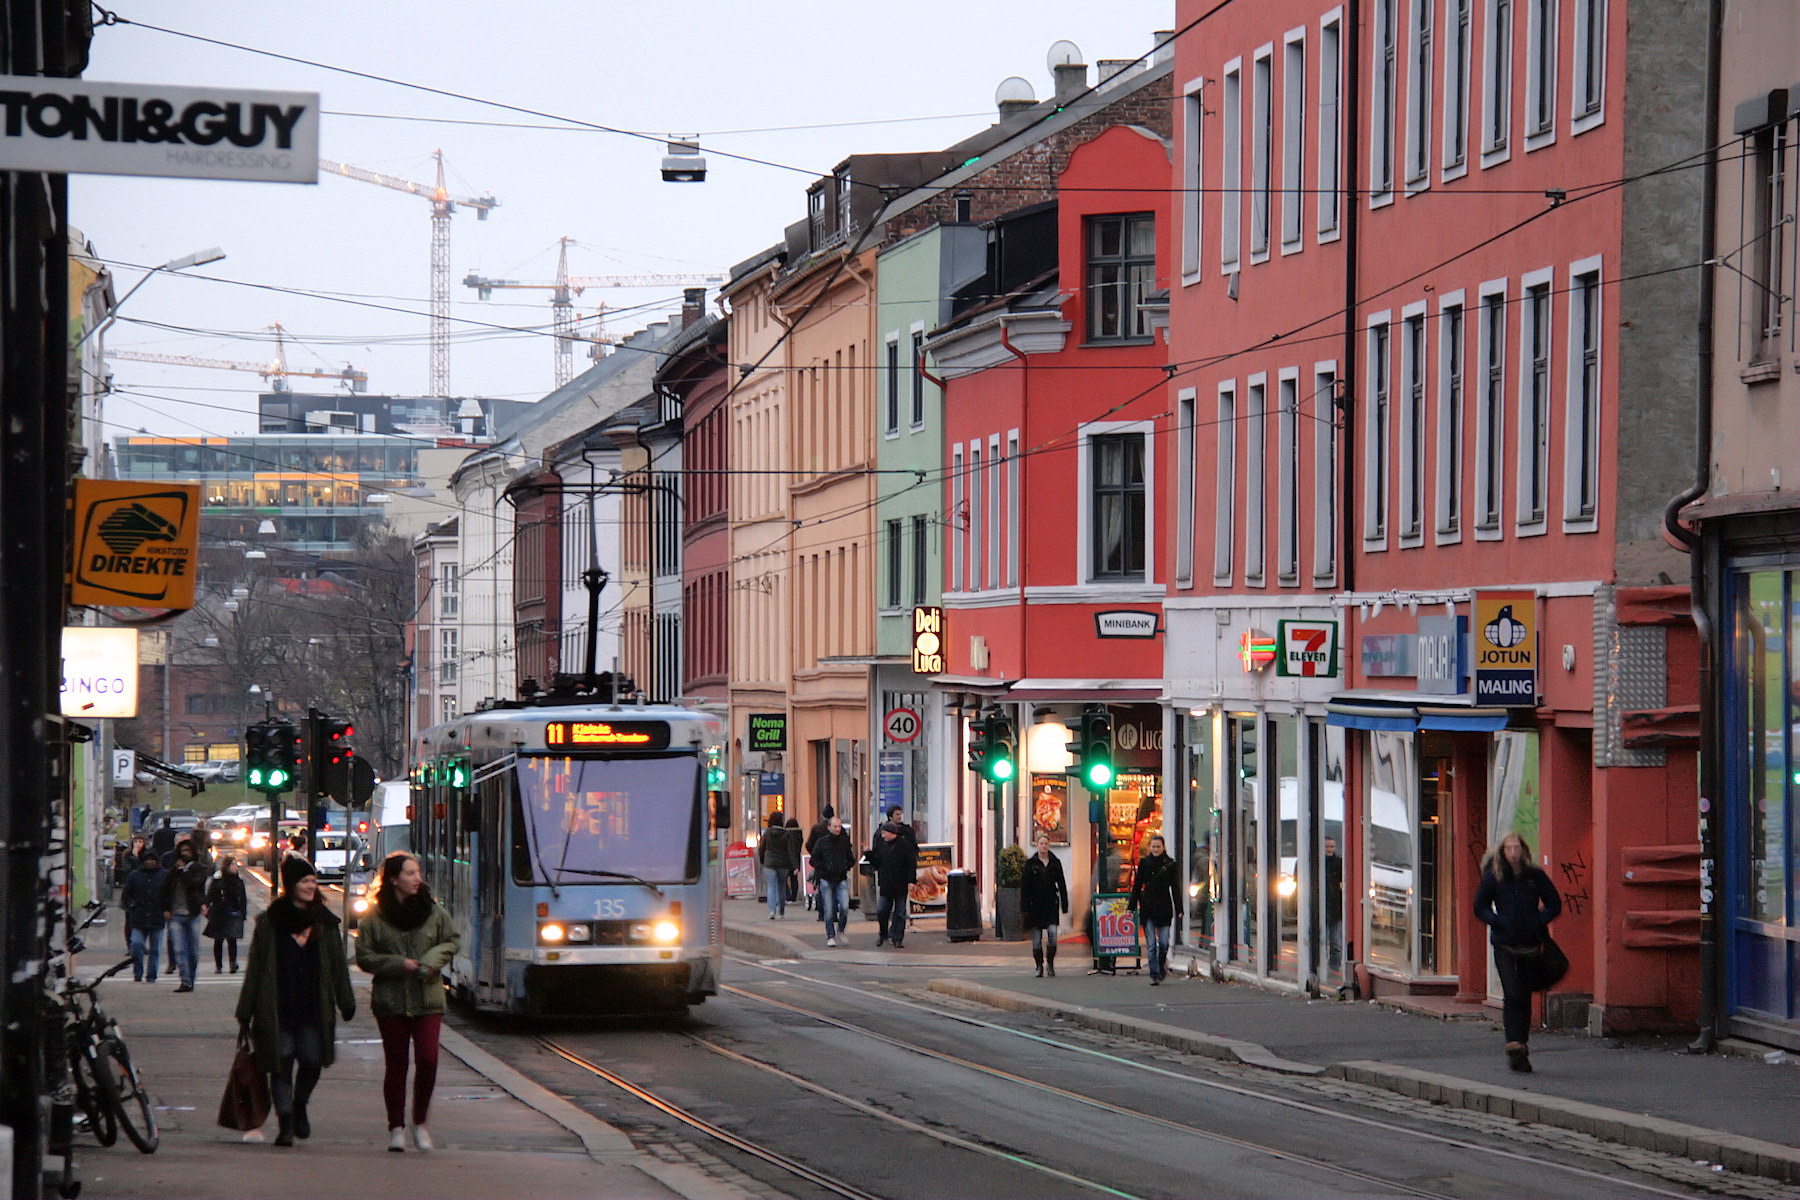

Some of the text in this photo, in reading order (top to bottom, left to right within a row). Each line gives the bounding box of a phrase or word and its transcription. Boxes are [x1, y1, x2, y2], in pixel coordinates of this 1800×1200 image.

[0, 91, 305, 149] TONI&GUY
[166, 151, 291, 169] HAIRDRESSING
[90, 554, 188, 576] DIREKTE
[915, 607, 940, 633] Deli
[1104, 619, 1151, 629] MINIBANK
[914, 647, 942, 673] Luca
[1291, 629, 1327, 677] 7
[1480, 650, 1531, 664] JOTUN
[1478, 679, 1533, 695] MALING
[752, 717, 785, 729] Noma
[890, 717, 914, 733] 40
[547, 723, 565, 744] 11
[756, 728, 781, 741] Grill
[118, 758, 129, 773] P
[593, 898, 625, 917] 135
[1099, 913, 1136, 937] 116
